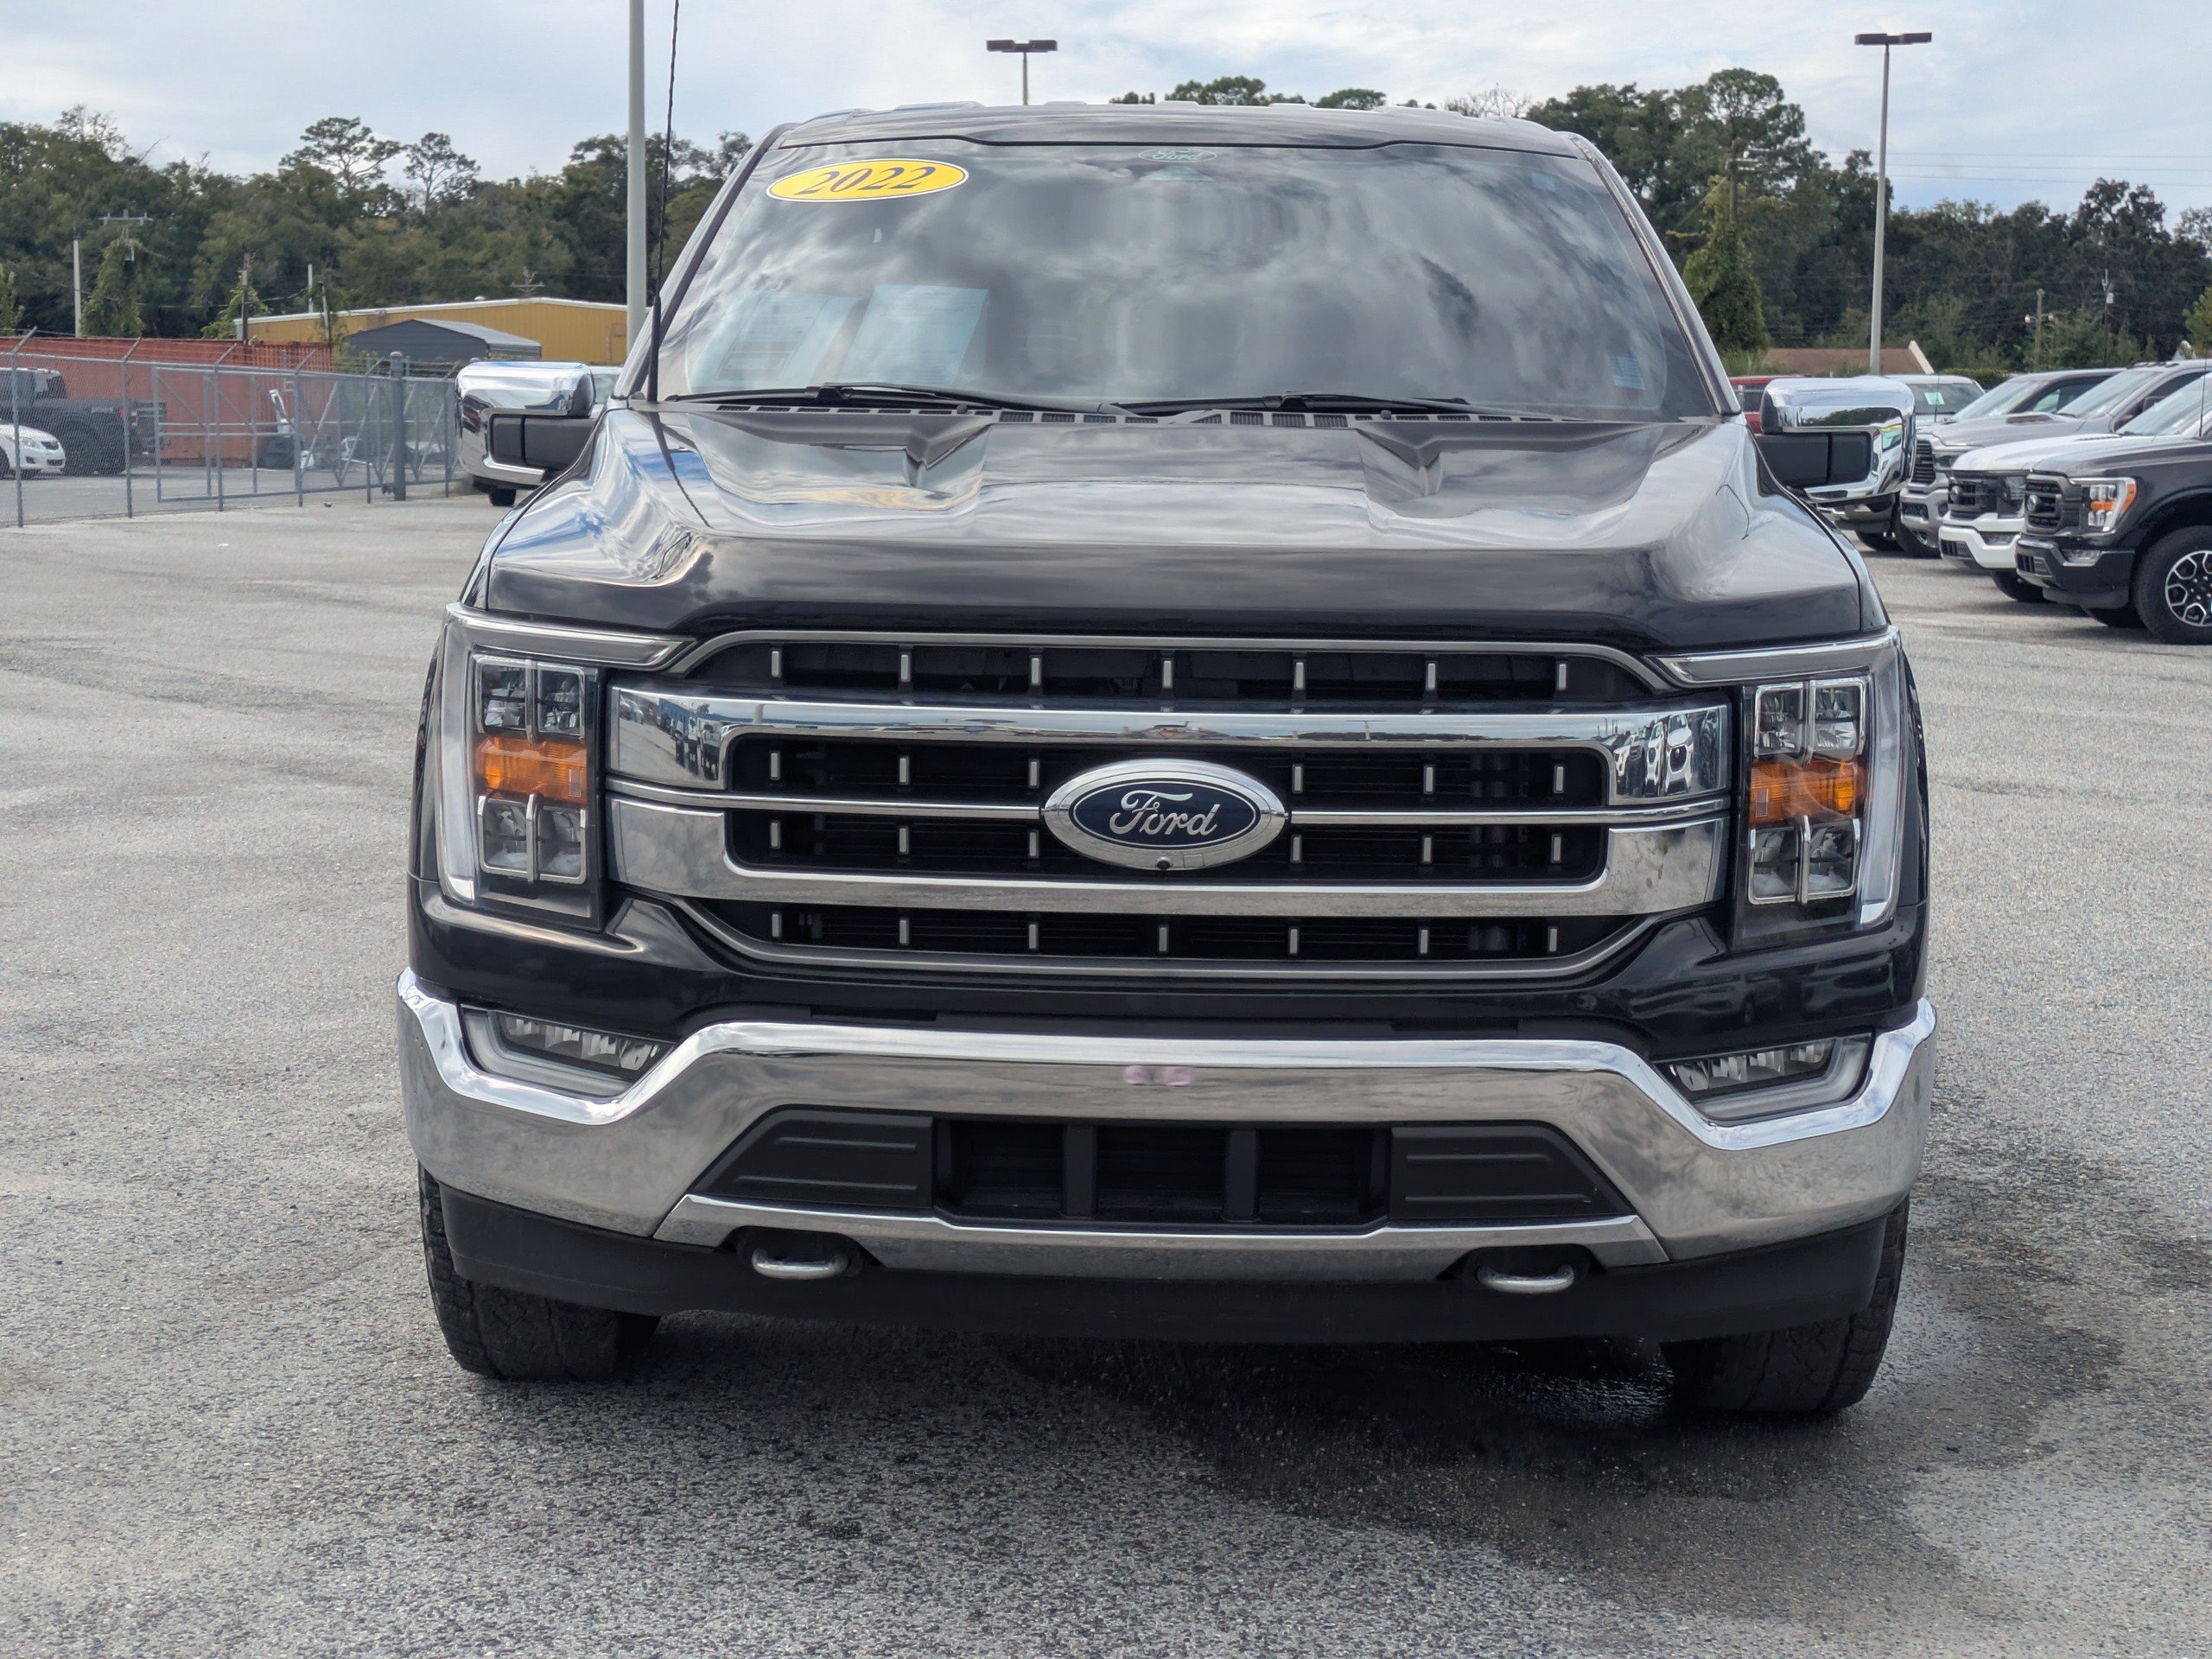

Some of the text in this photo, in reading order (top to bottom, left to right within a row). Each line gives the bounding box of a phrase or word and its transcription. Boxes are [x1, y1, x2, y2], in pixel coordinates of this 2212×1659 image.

[1152, 149, 1204, 161] Ford
[792, 166, 936, 196] 2022
[1109, 790, 1220, 836] Ford
